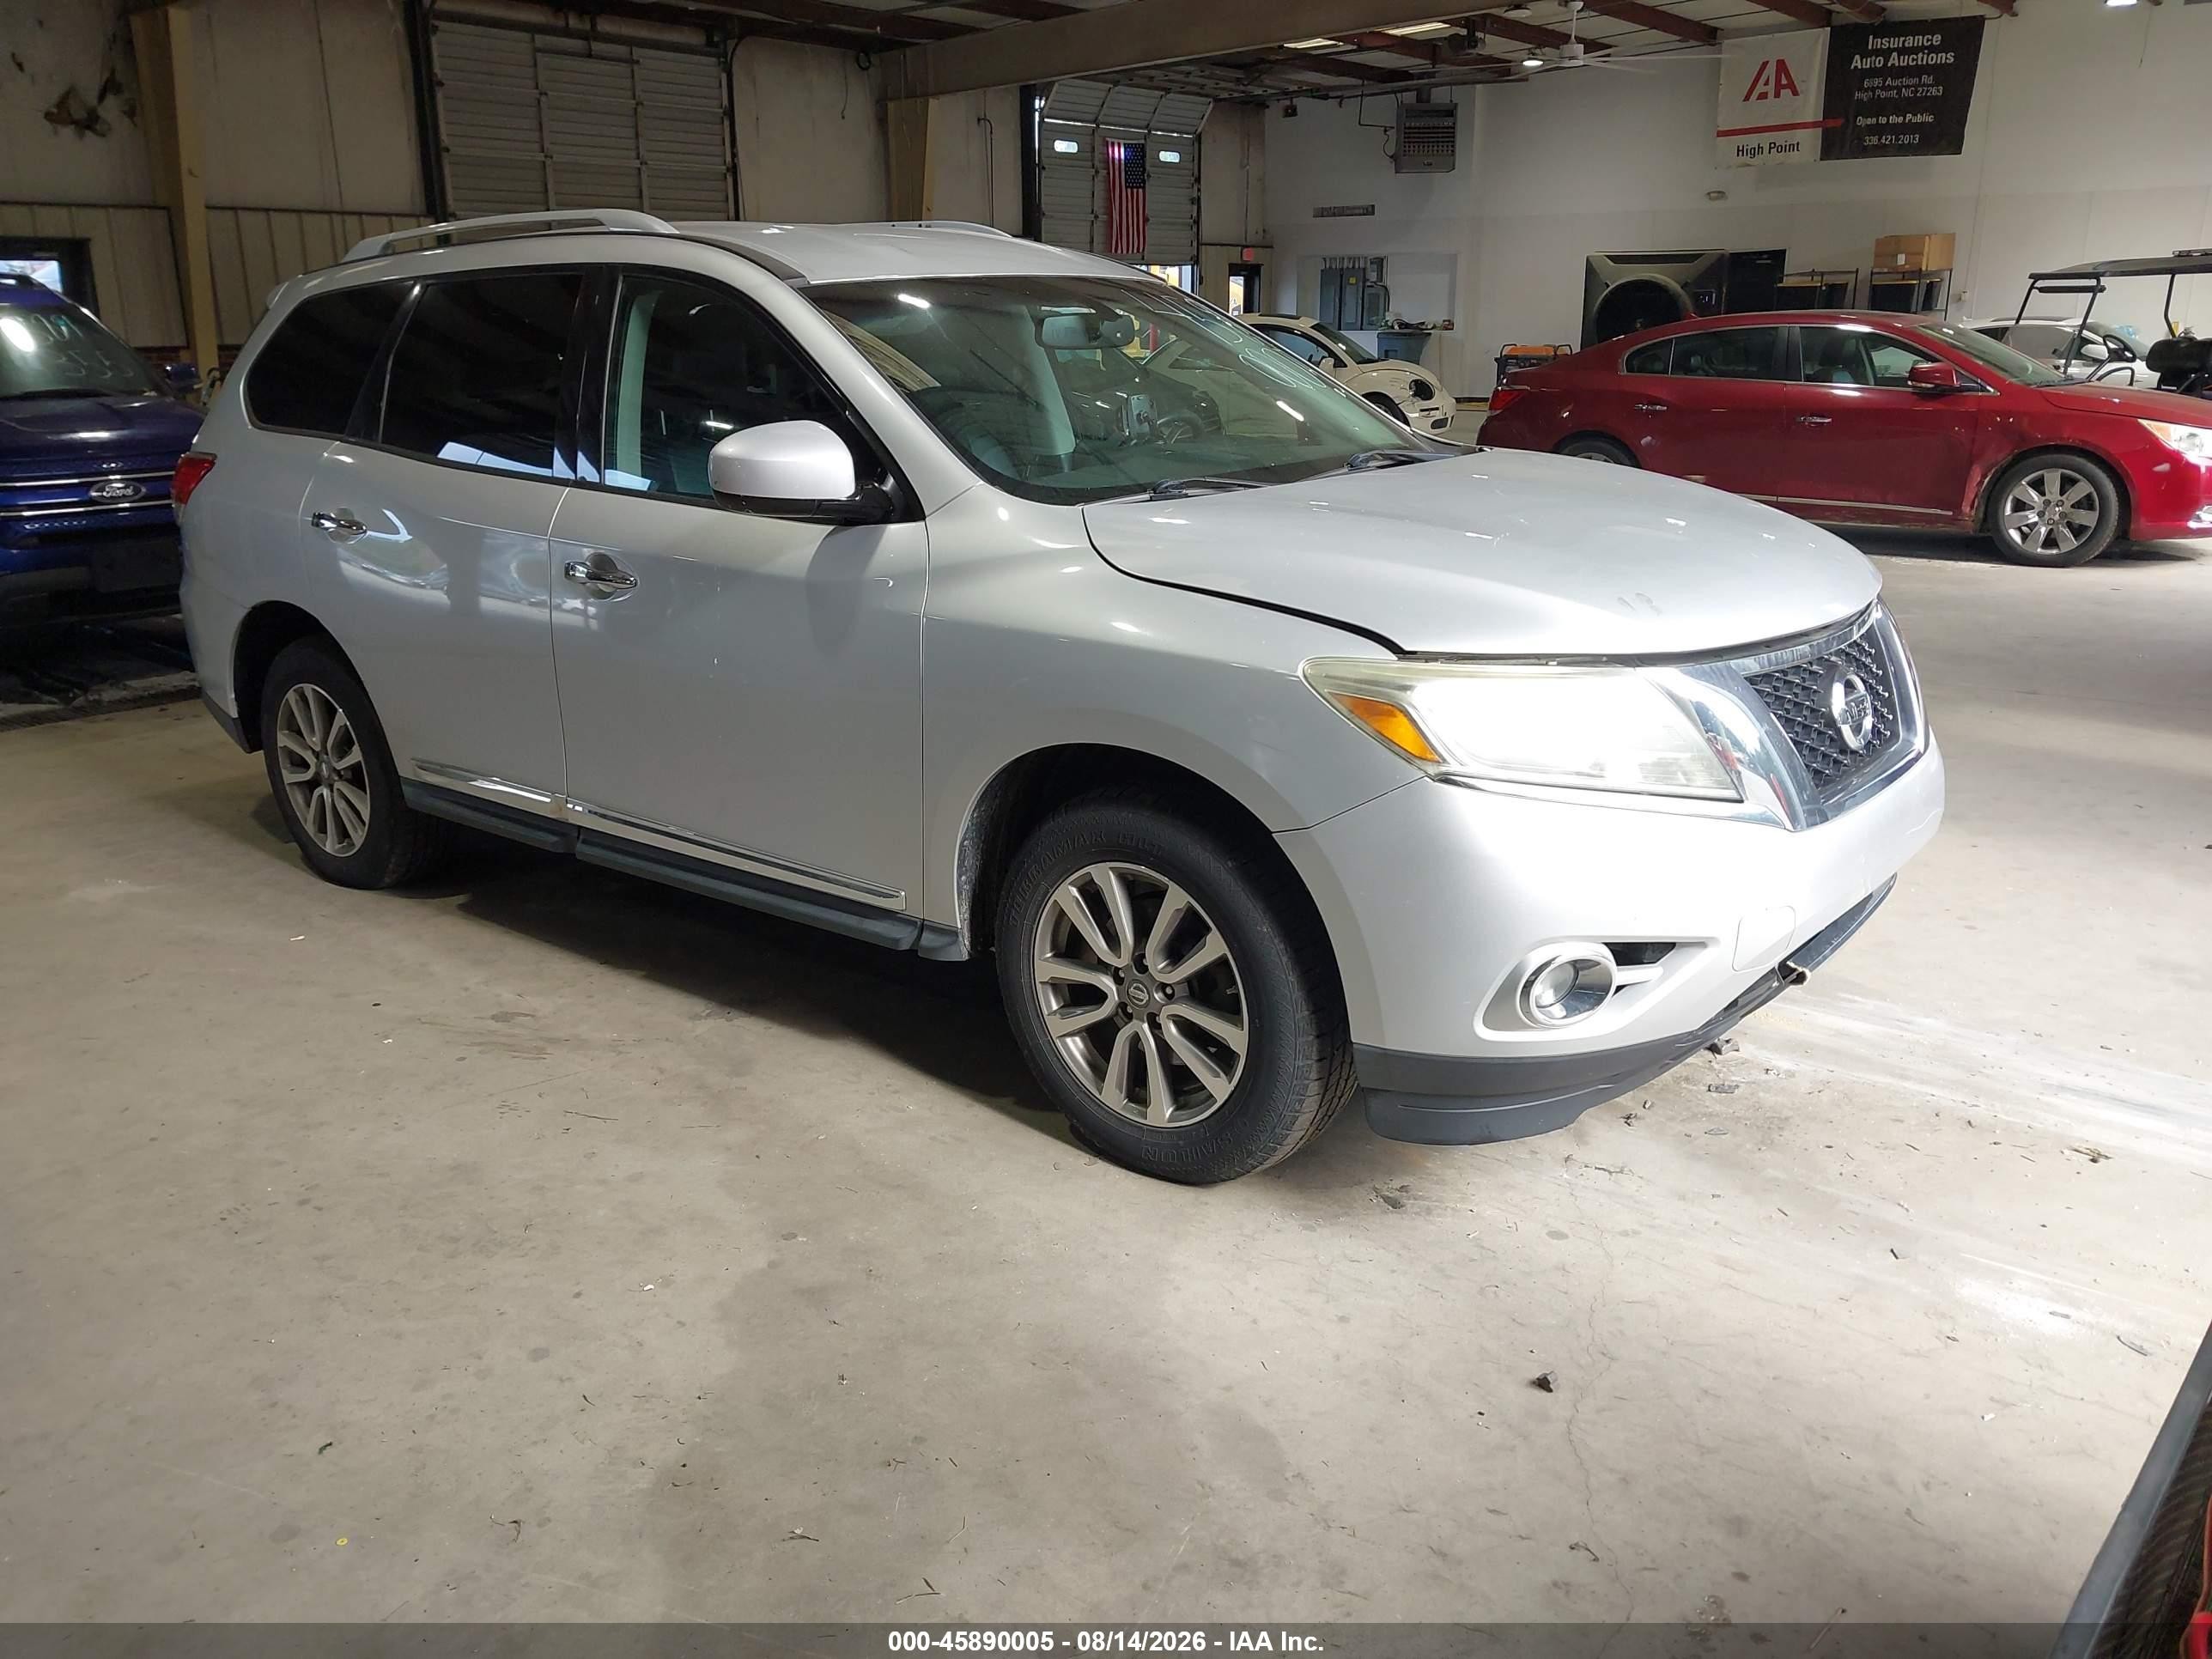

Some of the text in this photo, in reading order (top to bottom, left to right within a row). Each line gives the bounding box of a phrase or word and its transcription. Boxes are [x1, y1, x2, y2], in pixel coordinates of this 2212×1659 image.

[1868, 34, 1942, 50] Insurance
[1850, 51, 1955, 69] Auto Auctions
[1885, 76, 1919, 87] Auction
[1921, 75, 1936, 85] Rd.
[1855, 86, 1943, 101] High Point, NC 27263
[1856, 116, 1876, 127] Open
[1889, 114, 1904, 124] the
[1905, 113, 1936, 123] Public
[1736, 140, 1801, 159] High Point
[102, 483, 135, 498] Ford
